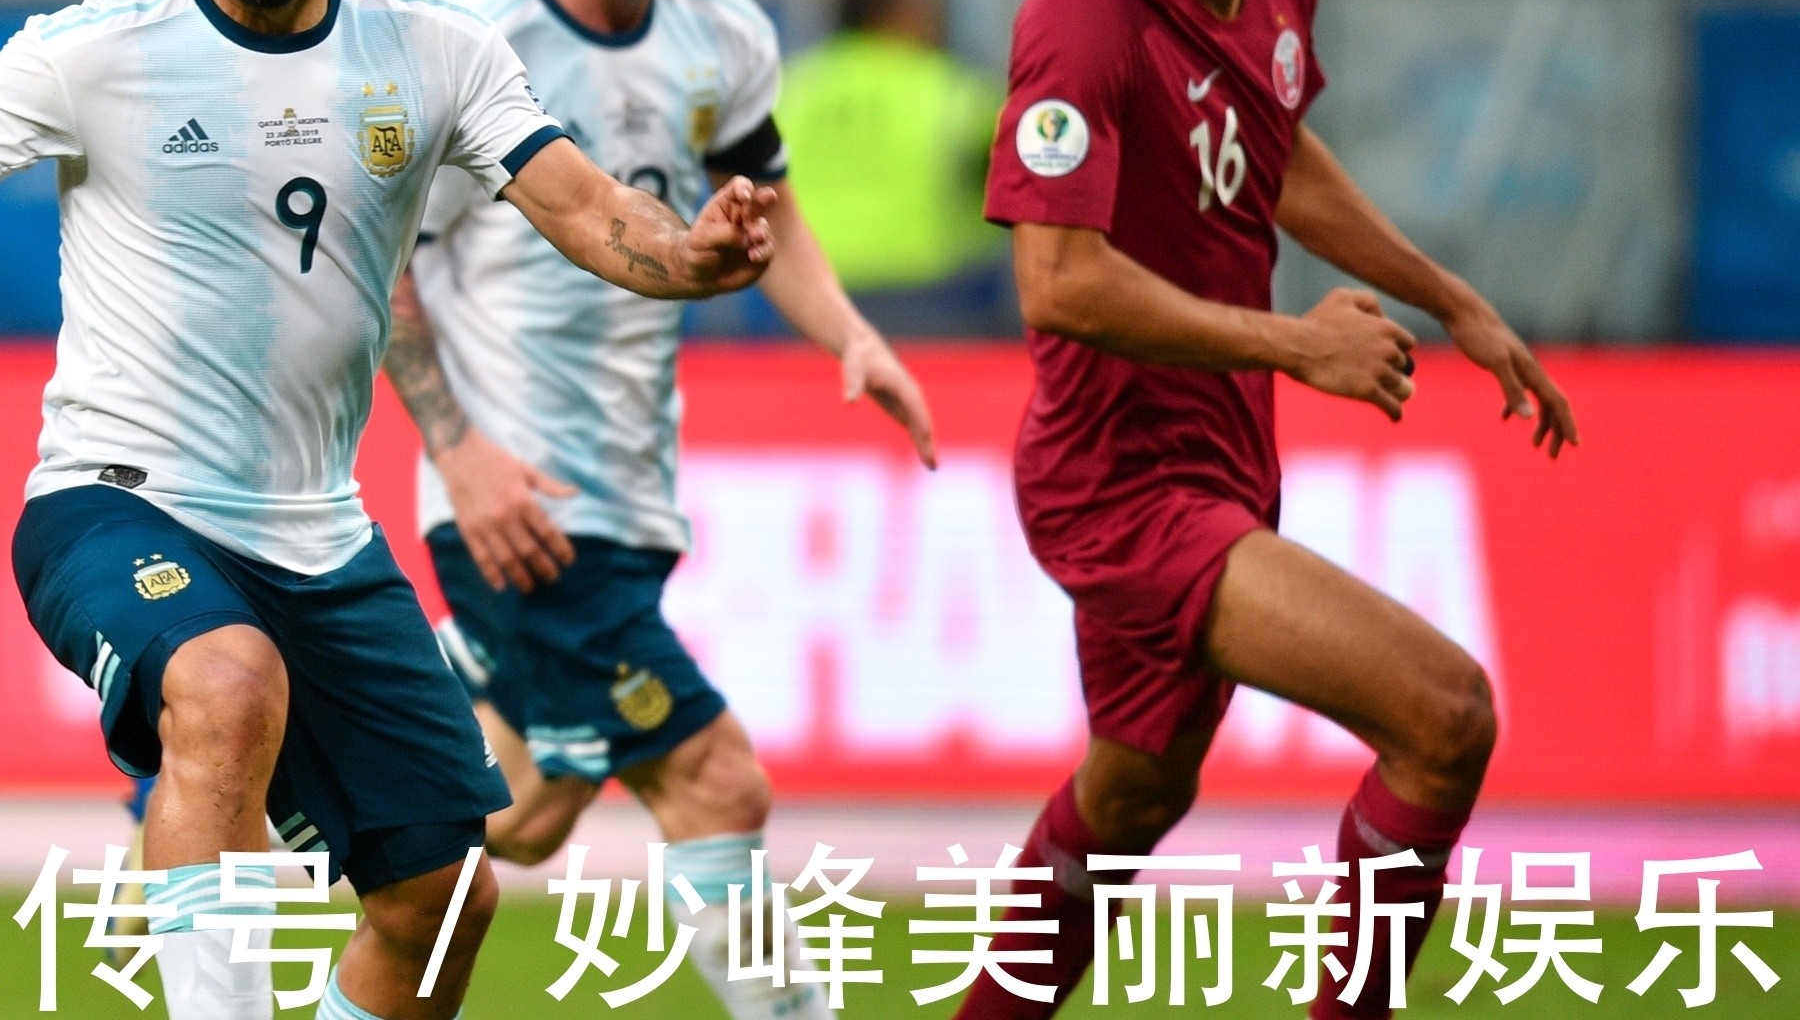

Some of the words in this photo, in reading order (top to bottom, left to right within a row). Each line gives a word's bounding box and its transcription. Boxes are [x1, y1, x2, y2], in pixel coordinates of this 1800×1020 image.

[258, 120, 283, 129] QATAR
[298, 117, 329, 125] ARGENTINA
[162, 140, 220, 154] adidas
[265, 139, 291, 147] PORTO
[292, 137, 323, 145] ALEGRE
[371, 126, 403, 158] AFA
[1189, 105, 1247, 214] 16
[275, 176, 328, 275] 9
